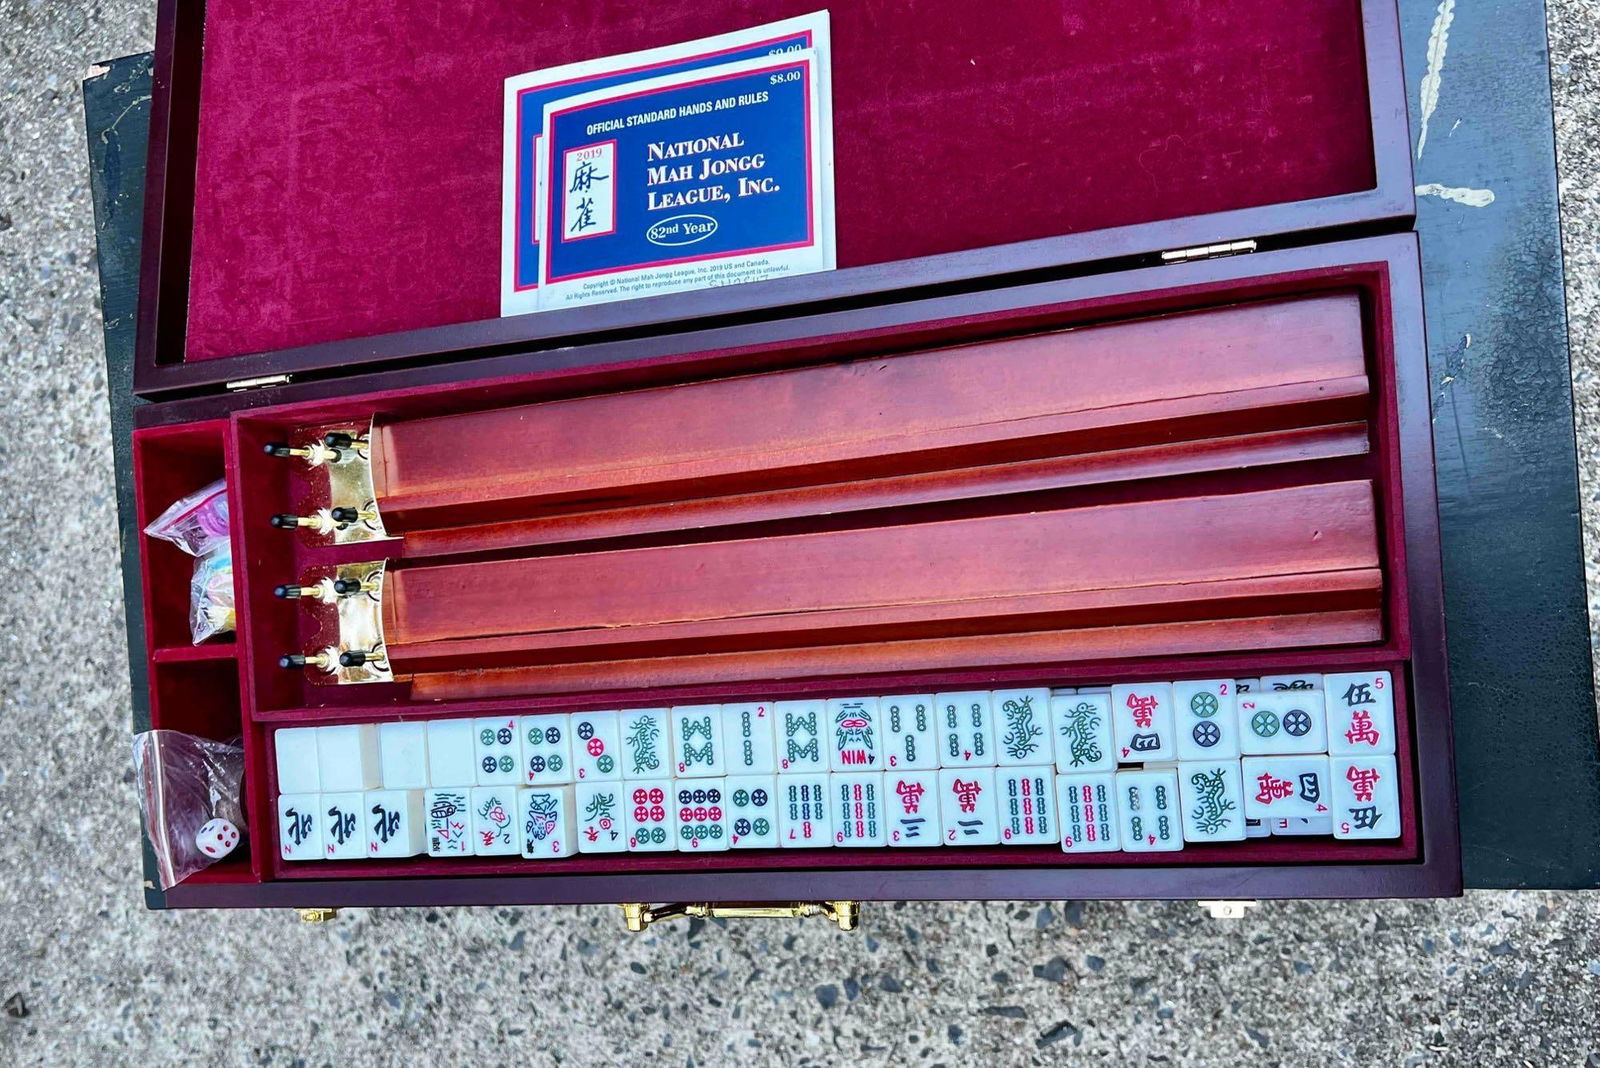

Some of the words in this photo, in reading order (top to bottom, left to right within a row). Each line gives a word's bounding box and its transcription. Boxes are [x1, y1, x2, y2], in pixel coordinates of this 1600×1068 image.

[770, 71, 800, 85] $8.00
[586, 120, 625, 135] OFFICIAL
[626, 109, 676, 127] STANDARD
[680, 101, 713, 117] HANDS
[714, 97, 735, 111] AND
[738, 91, 768, 108] RULES
[647, 132, 744, 162] NATIONAL
[576, 148, 603, 162] 2019
[647, 164, 693, 186] MAH
[699, 154, 766, 180] JONGG
[647, 184, 731, 211] LEAGUE,
[738, 176, 780, 197] INC.
[650, 223, 678, 240] 82nd
[684, 222, 714, 235] Year
[574, 291, 590, 300] Rights
[652, 279, 681, 288] reproduce
[726, 269, 755, 278] document
[583, 280, 609, 290] Copyright
[616, 276, 640, 284] National
[655, 271, 672, 280] Jongg
[1375, 678, 1384, 689] 5
[1220, 684, 1227, 695] 2
[758, 707, 765, 718] 2
[508, 720, 514, 730] 4
[841, 750, 866, 764] WIN
[964, 751, 971, 761] 4
[1122, 747, 1130, 757] 4
[782, 759, 789, 769] 8
[867, 753, 875, 764] 4
[890, 756, 896, 766] 3
[679, 762, 685, 772] 8
[528, 770, 535, 780] 4
[578, 768, 585, 778] 3
[1316, 804, 1328, 812] 4
[285, 807, 312, 846] 北
[328, 806, 356, 845] 北
[372, 804, 400, 843] 北
[1341, 822, 1350, 834] 5
[503, 834, 510, 843] 2
[610, 831, 618, 841] 4
[732, 834, 738, 845] 4
[789, 829, 796, 839] 7
[837, 831, 843, 841] 9
[893, 830, 900, 841] 3
[948, 830, 955, 840] 2
[1004, 829, 1011, 839] 9
[1148, 834, 1156, 845] 4
[371, 842, 378, 851] N
[553, 841, 559, 852] 3
[692, 837, 698, 848] 9
[1065, 836, 1072, 847] 9
[285, 844, 291, 854] N
[327, 844, 334, 853] N
